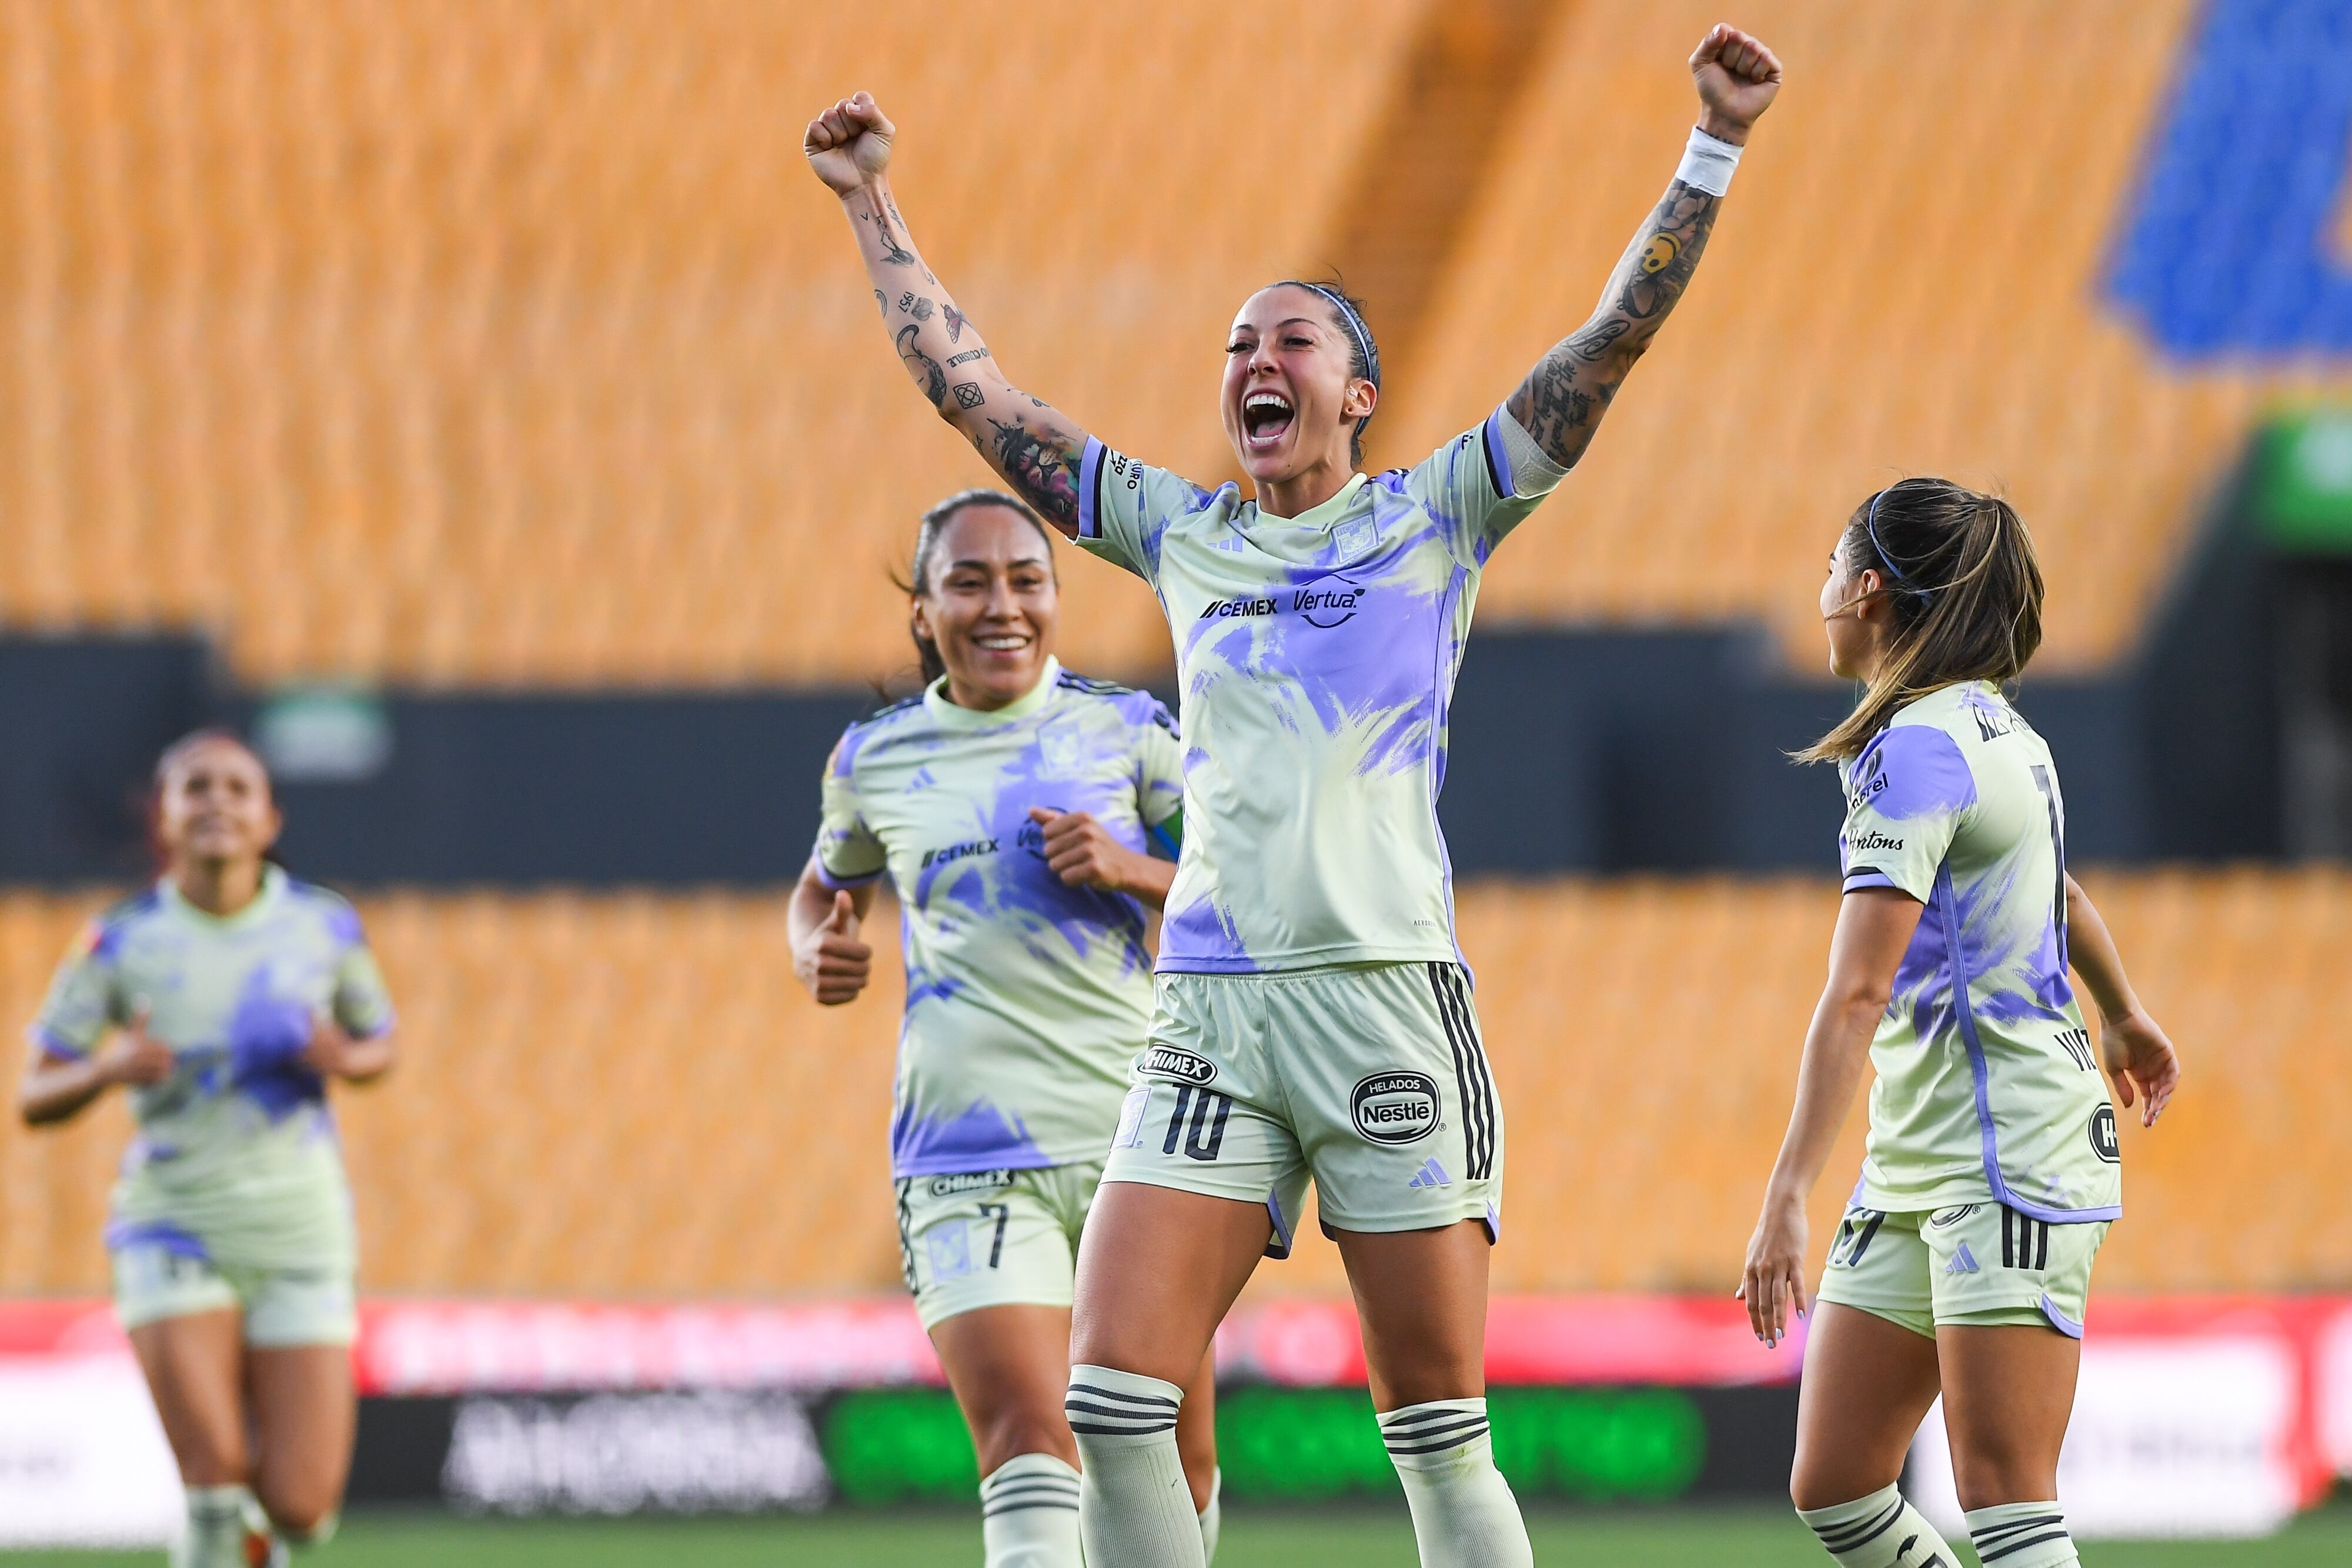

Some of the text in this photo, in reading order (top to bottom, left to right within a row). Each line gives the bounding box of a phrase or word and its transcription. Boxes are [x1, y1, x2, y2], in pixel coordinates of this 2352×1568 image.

[1219, 599, 1278, 617] CEMEX
[1369, 1079, 1421, 1094] HELADOS
[1162, 1083, 1232, 1161] 10
[977, 1203, 1008, 1269] 7
